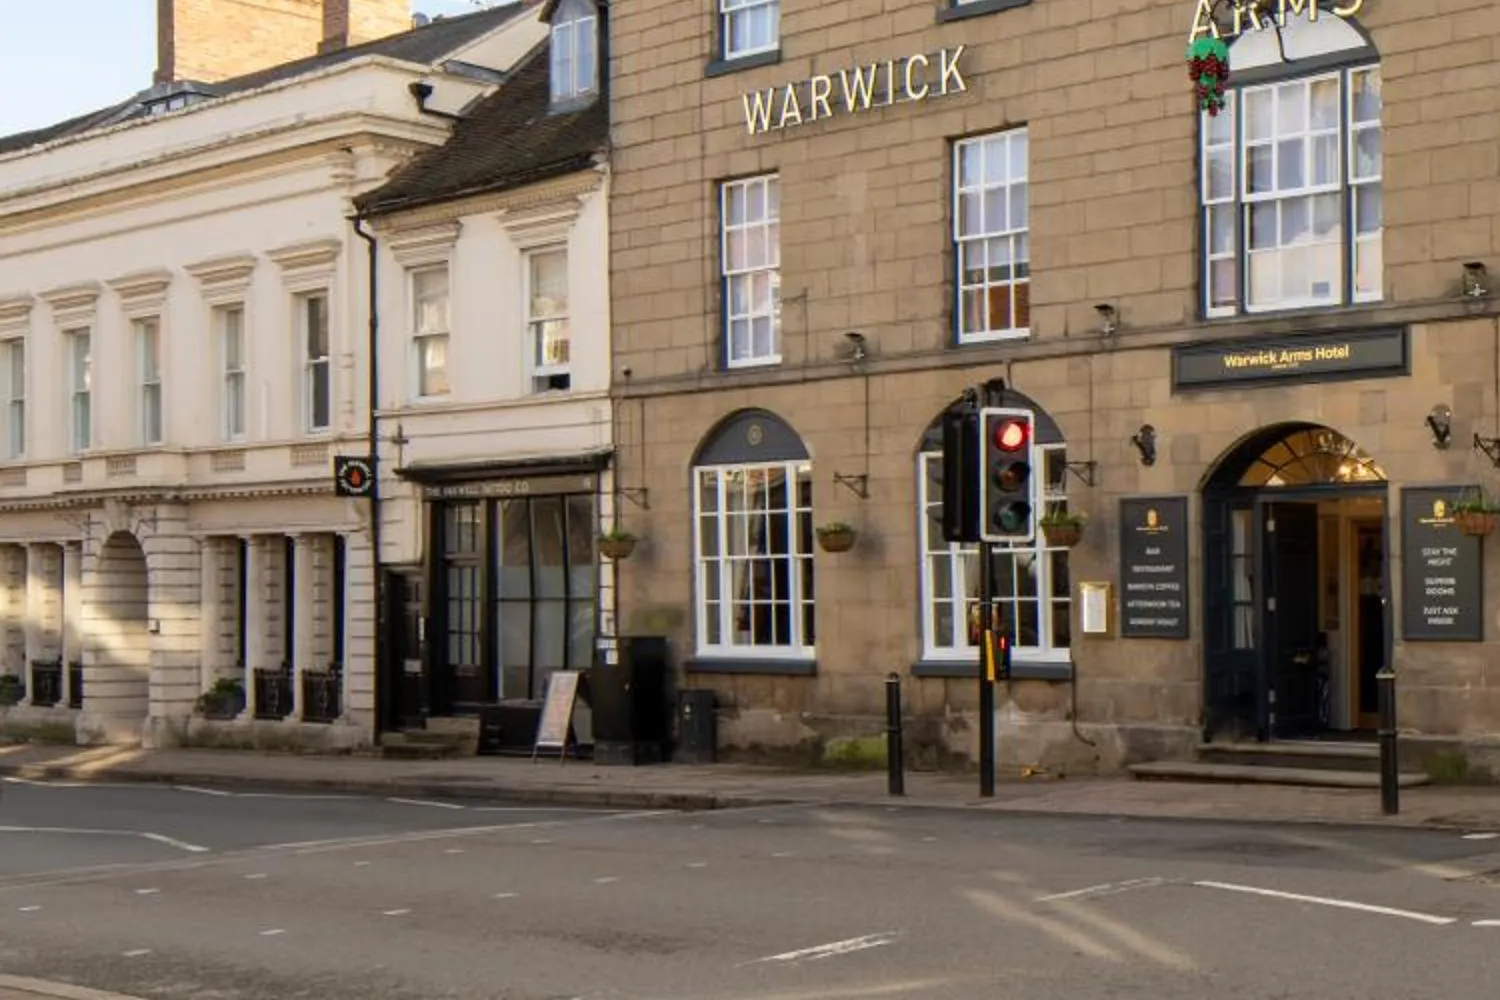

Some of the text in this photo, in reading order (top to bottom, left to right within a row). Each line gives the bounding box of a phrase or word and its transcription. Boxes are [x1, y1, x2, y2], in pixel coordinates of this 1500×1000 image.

[743, 45, 967, 135] WARWICK
[1223, 350, 1277, 368] Warwick
[1279, 350, 1313, 364] Arms
[1315, 344, 1349, 360] Hotel
